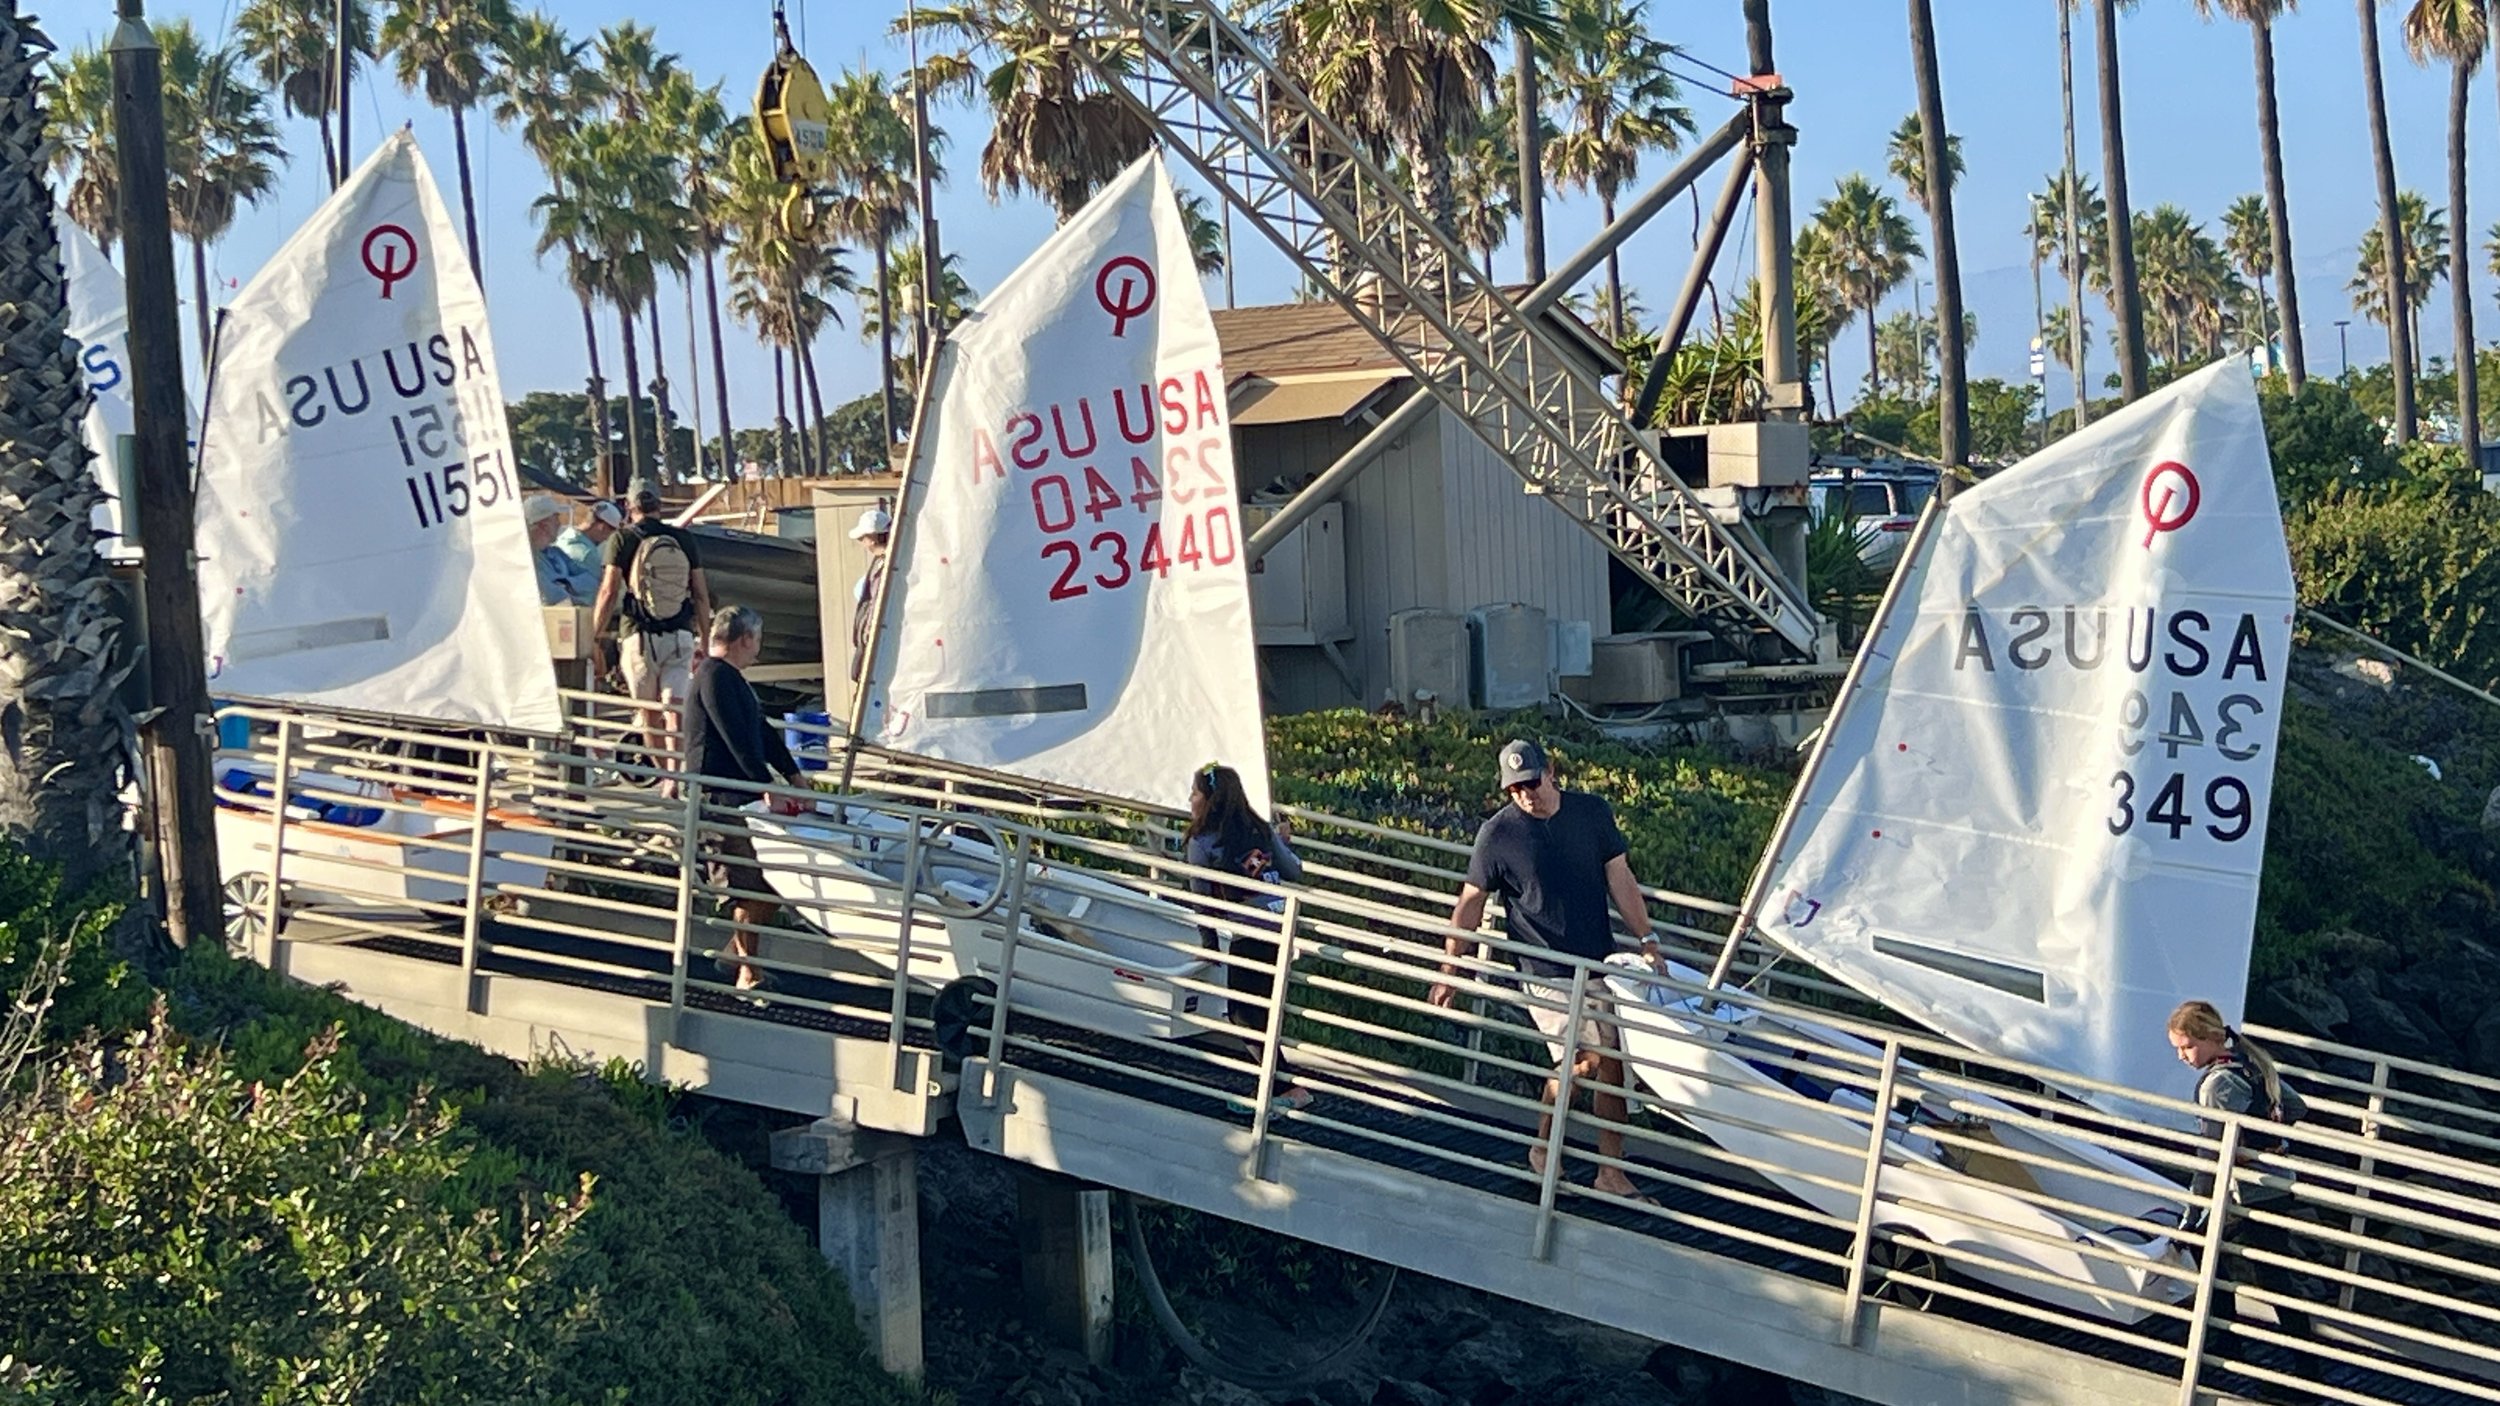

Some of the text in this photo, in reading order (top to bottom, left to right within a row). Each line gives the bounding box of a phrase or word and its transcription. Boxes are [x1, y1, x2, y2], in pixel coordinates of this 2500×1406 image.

[383, 325, 486, 398] USA
[1112, 370, 1220, 444] USA
[406, 449, 513, 528] 11551
[1041, 506, 1235, 602] 23440
[2127, 606, 2268, 682] USA
[2107, 770, 2251, 842] 349
